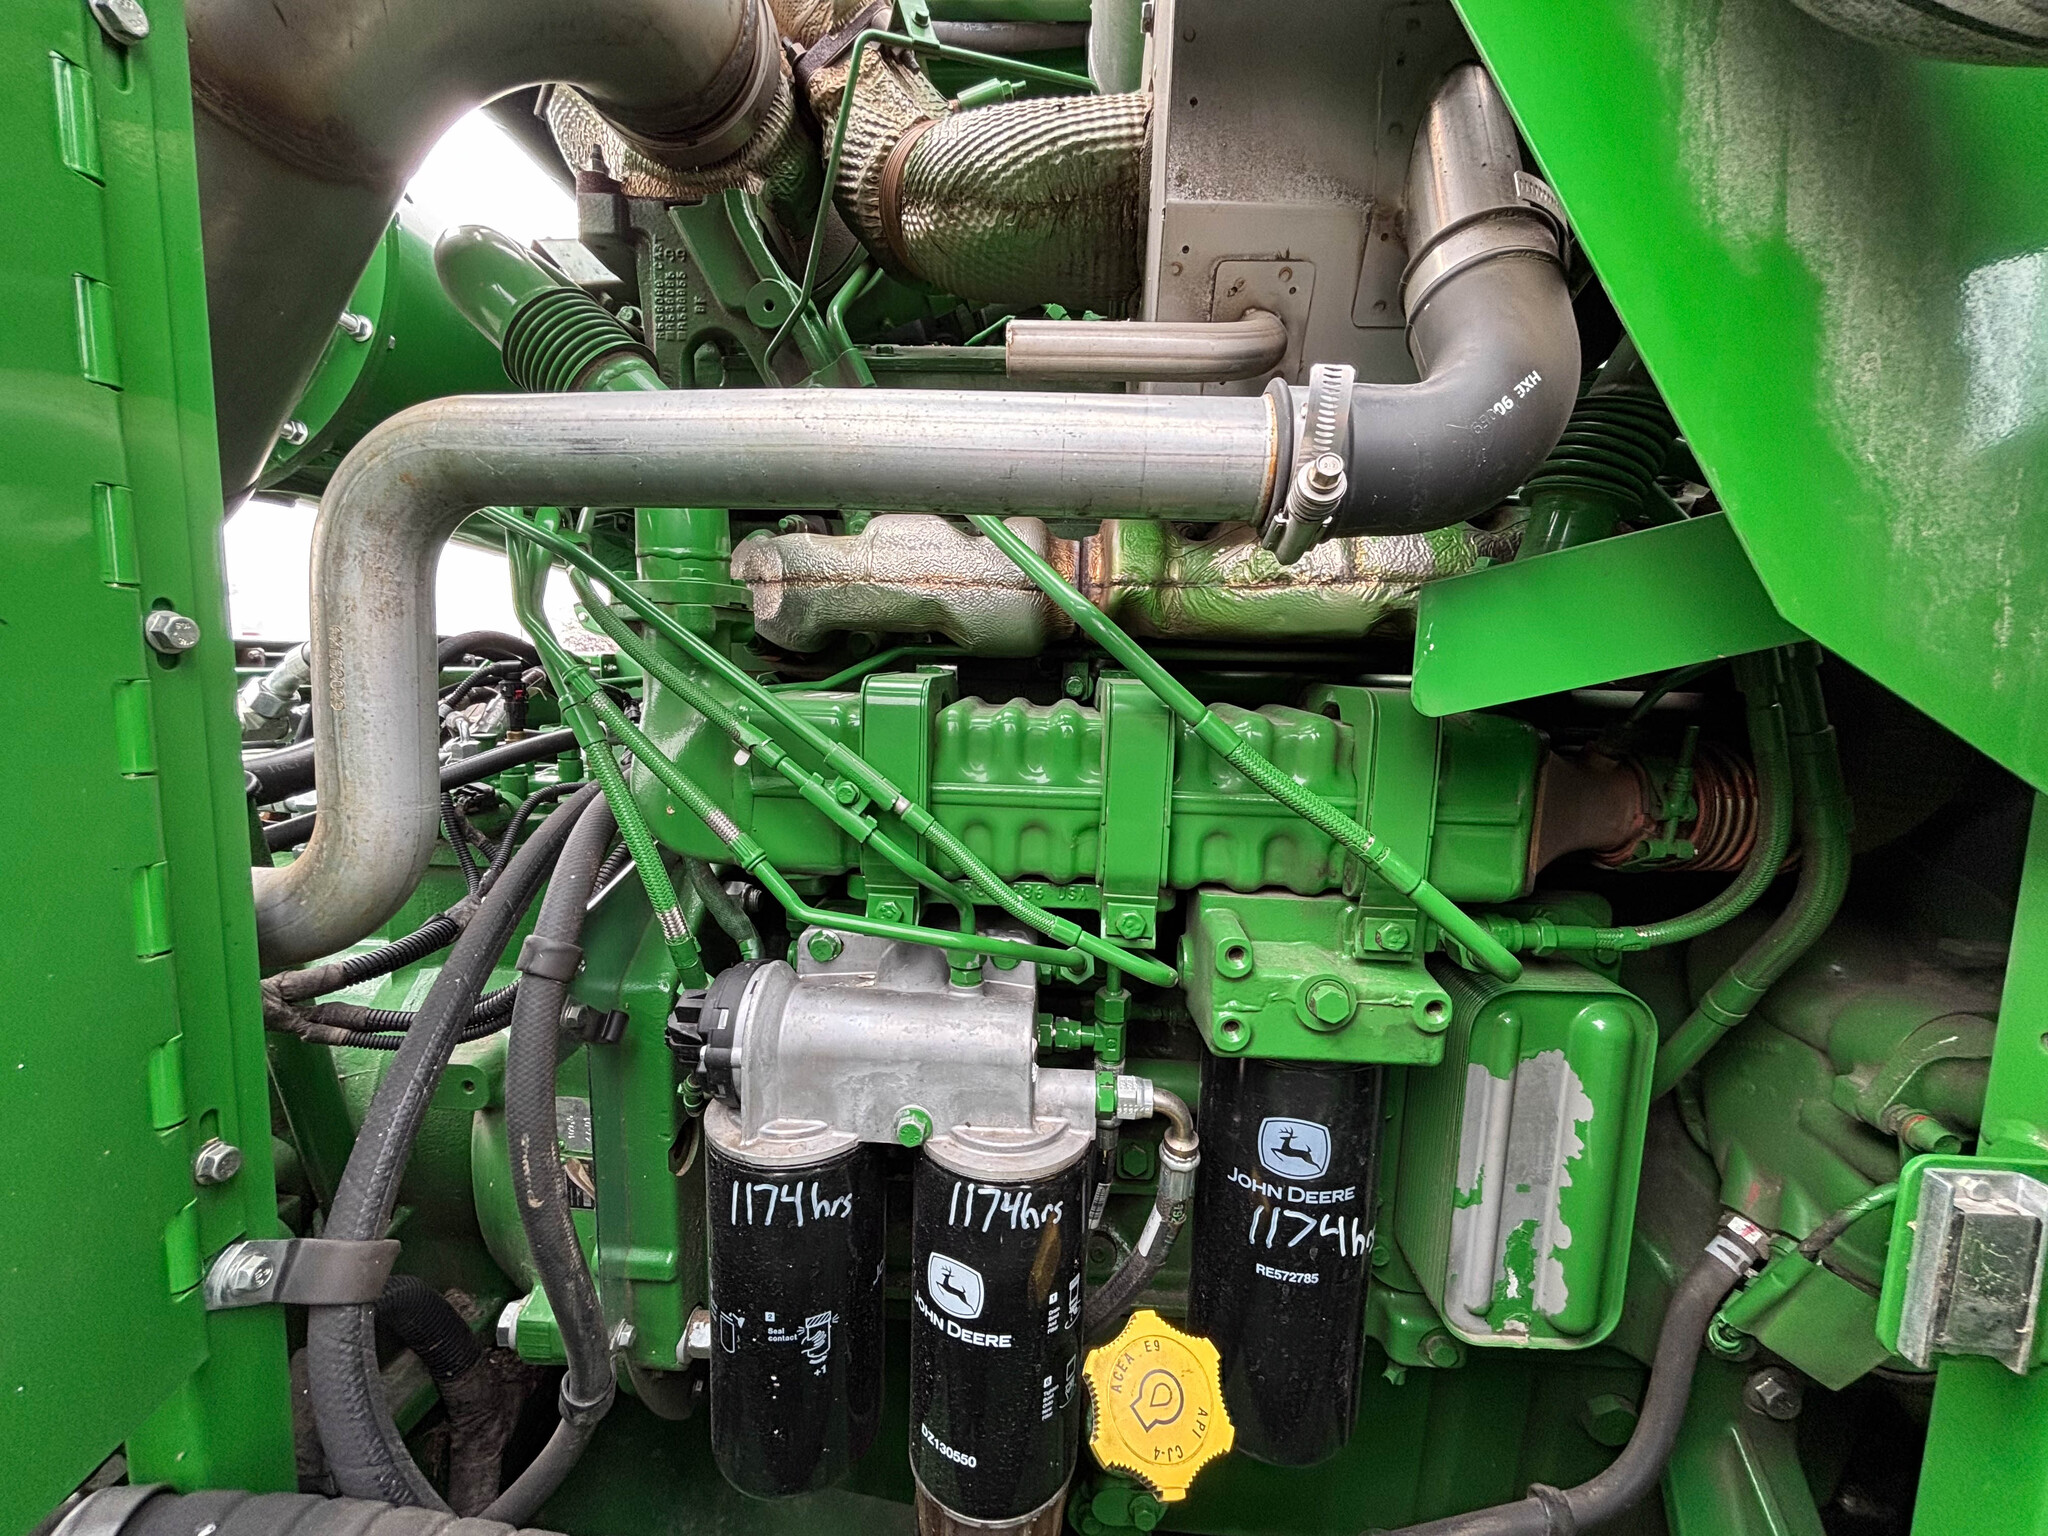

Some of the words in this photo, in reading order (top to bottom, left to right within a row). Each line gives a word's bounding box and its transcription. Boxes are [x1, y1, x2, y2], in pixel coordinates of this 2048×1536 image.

[1514, 370, 1542, 398] HXE
[1058, 886, 1088, 901] USA
[1227, 1167, 1283, 1200] JOHN
[1288, 1186, 1356, 1204] DEERE
[1255, 1262, 1320, 1284] RE572785
[767, 1327, 785, 1335] Seal
[914, 1289, 945, 1331] JOHN
[946, 1319, 1012, 1348] DEERE
[767, 1334, 798, 1342] contact
[813, 1364, 827, 1377] +1
[1111, 1352, 1135, 1394] ACEA
[1144, 1339, 1161, 1353] E9
[1192, 1406, 1209, 1439] API
[921, 1422, 977, 1469] DZ130550
[1154, 1445, 1184, 1462] CJ-4
